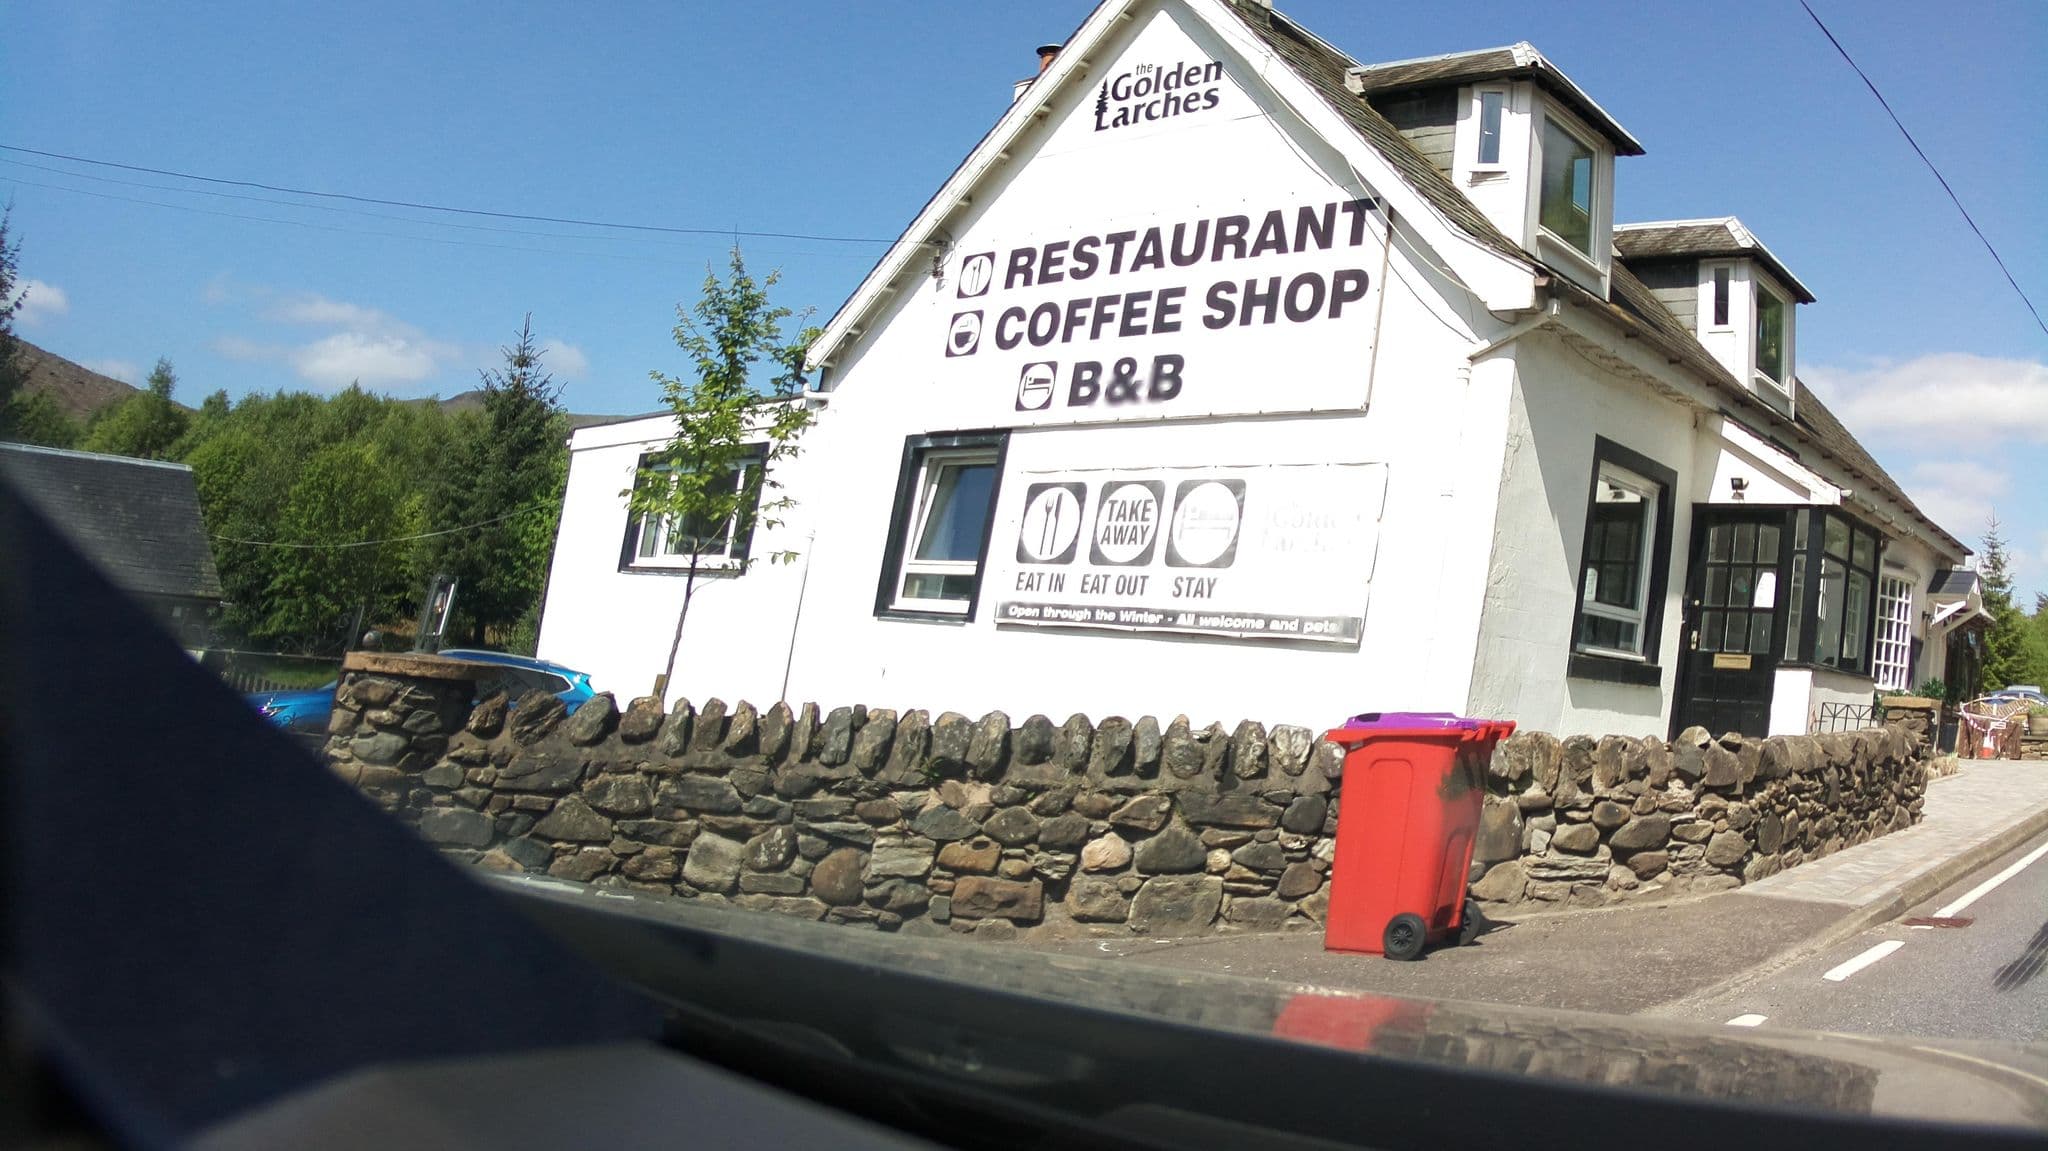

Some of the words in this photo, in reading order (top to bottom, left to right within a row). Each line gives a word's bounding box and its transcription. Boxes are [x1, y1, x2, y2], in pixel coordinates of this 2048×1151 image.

[1111, 61, 1223, 101] Golden
[1136, 63, 1153, 75] the
[1095, 88, 1219, 132] Larches
[1004, 197, 1380, 289] RESTAURANT
[995, 286, 1187, 351] COFFEE
[1202, 269, 1369, 329] SHOP
[1067, 354, 1185, 407] B&B
[1108, 499, 1154, 522] TAKE
[1100, 525, 1150, 545] AWAY
[1015, 571, 1045, 592] EAT
[1048, 573, 1066, 593] IN
[1080, 573, 1111, 595] EAT
[1115, 574, 1149, 596] OUT
[1172, 576, 1217, 599] STAY
[1008, 605, 1040, 618] Open
[1043, 606, 1091, 621] through
[1095, 609, 1116, 622] the
[1119, 610, 1164, 624] Winter
[1176, 613, 1195, 626] All
[1199, 614, 1266, 630] welcome
[1269, 617, 1299, 632] and
